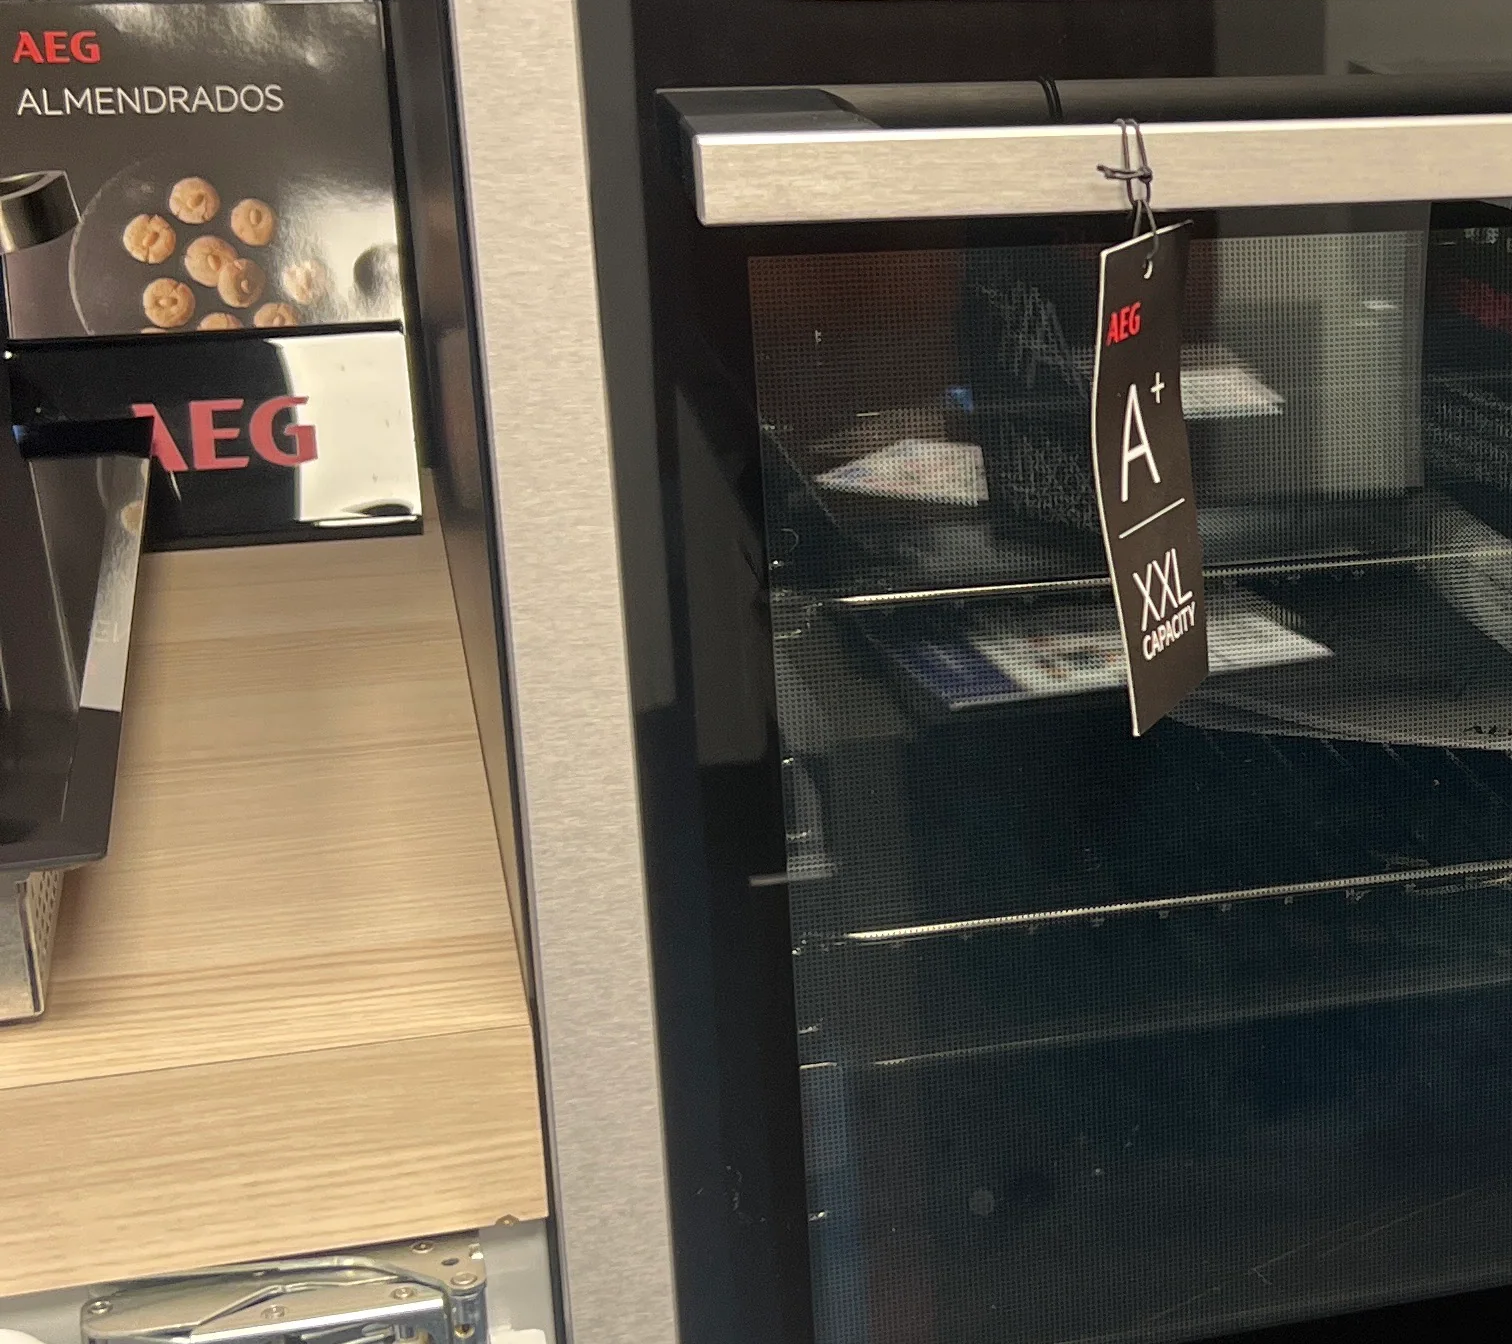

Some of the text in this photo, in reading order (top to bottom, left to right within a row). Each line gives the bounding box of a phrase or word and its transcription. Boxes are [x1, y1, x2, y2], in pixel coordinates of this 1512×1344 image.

[13, 30, 101, 65] AEG
[16, 83, 286, 117] ALMENDRADOS
[1106, 301, 1142, 346] AEG
[1132, 547, 1194, 632] XXL
[1142, 601, 1196, 662] CAPACITY
